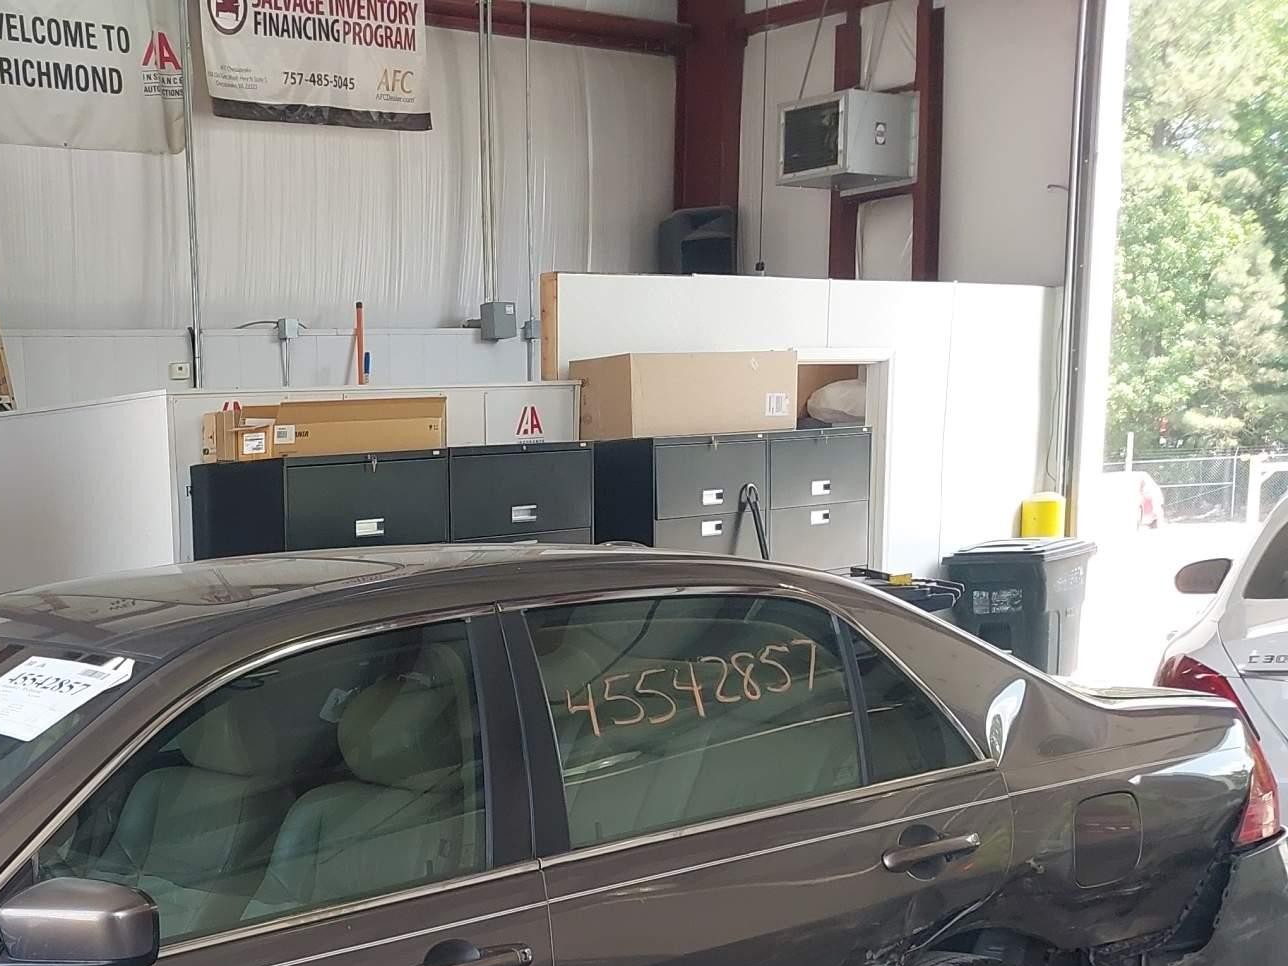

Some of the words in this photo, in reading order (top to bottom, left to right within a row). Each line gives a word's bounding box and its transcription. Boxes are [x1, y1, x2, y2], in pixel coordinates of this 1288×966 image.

[252, 0, 325, 15] VAGE
[328, 0, 418, 26] INVENTORY
[102, 24, 130, 53] TO
[254, 11, 340, 42] FINANCING
[343, 21, 416, 51] PROGRAM
[143, 71, 183, 84] INSANCE
[283, 72, 355, 90] 757-485-5045
[377, 68, 414, 93] AFC
[162, 87, 183, 96] CTIONS
[566, 639, 816, 737] 45542857
